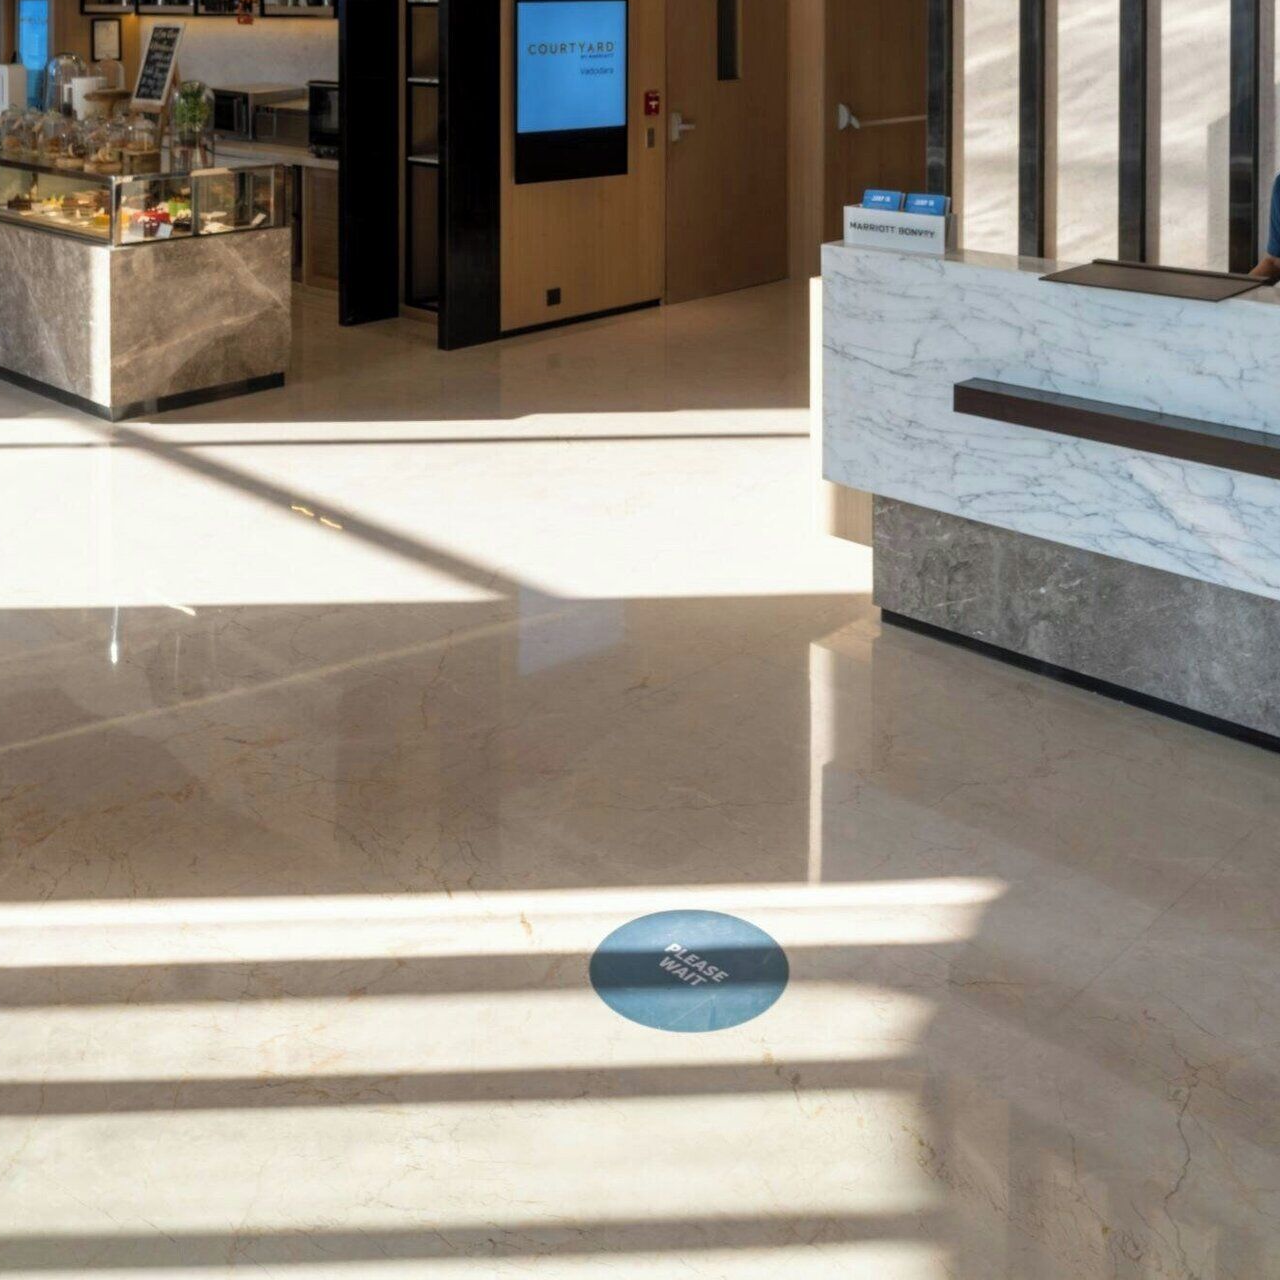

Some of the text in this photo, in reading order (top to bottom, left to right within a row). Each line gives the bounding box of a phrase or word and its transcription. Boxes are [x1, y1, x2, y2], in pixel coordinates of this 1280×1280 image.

[528, 42, 614, 56] COURTYARD
[849, 221, 896, 234] MARRIOTT
[659, 956, 708, 985] WAIT
[664, 943, 729, 983] PLEASE
